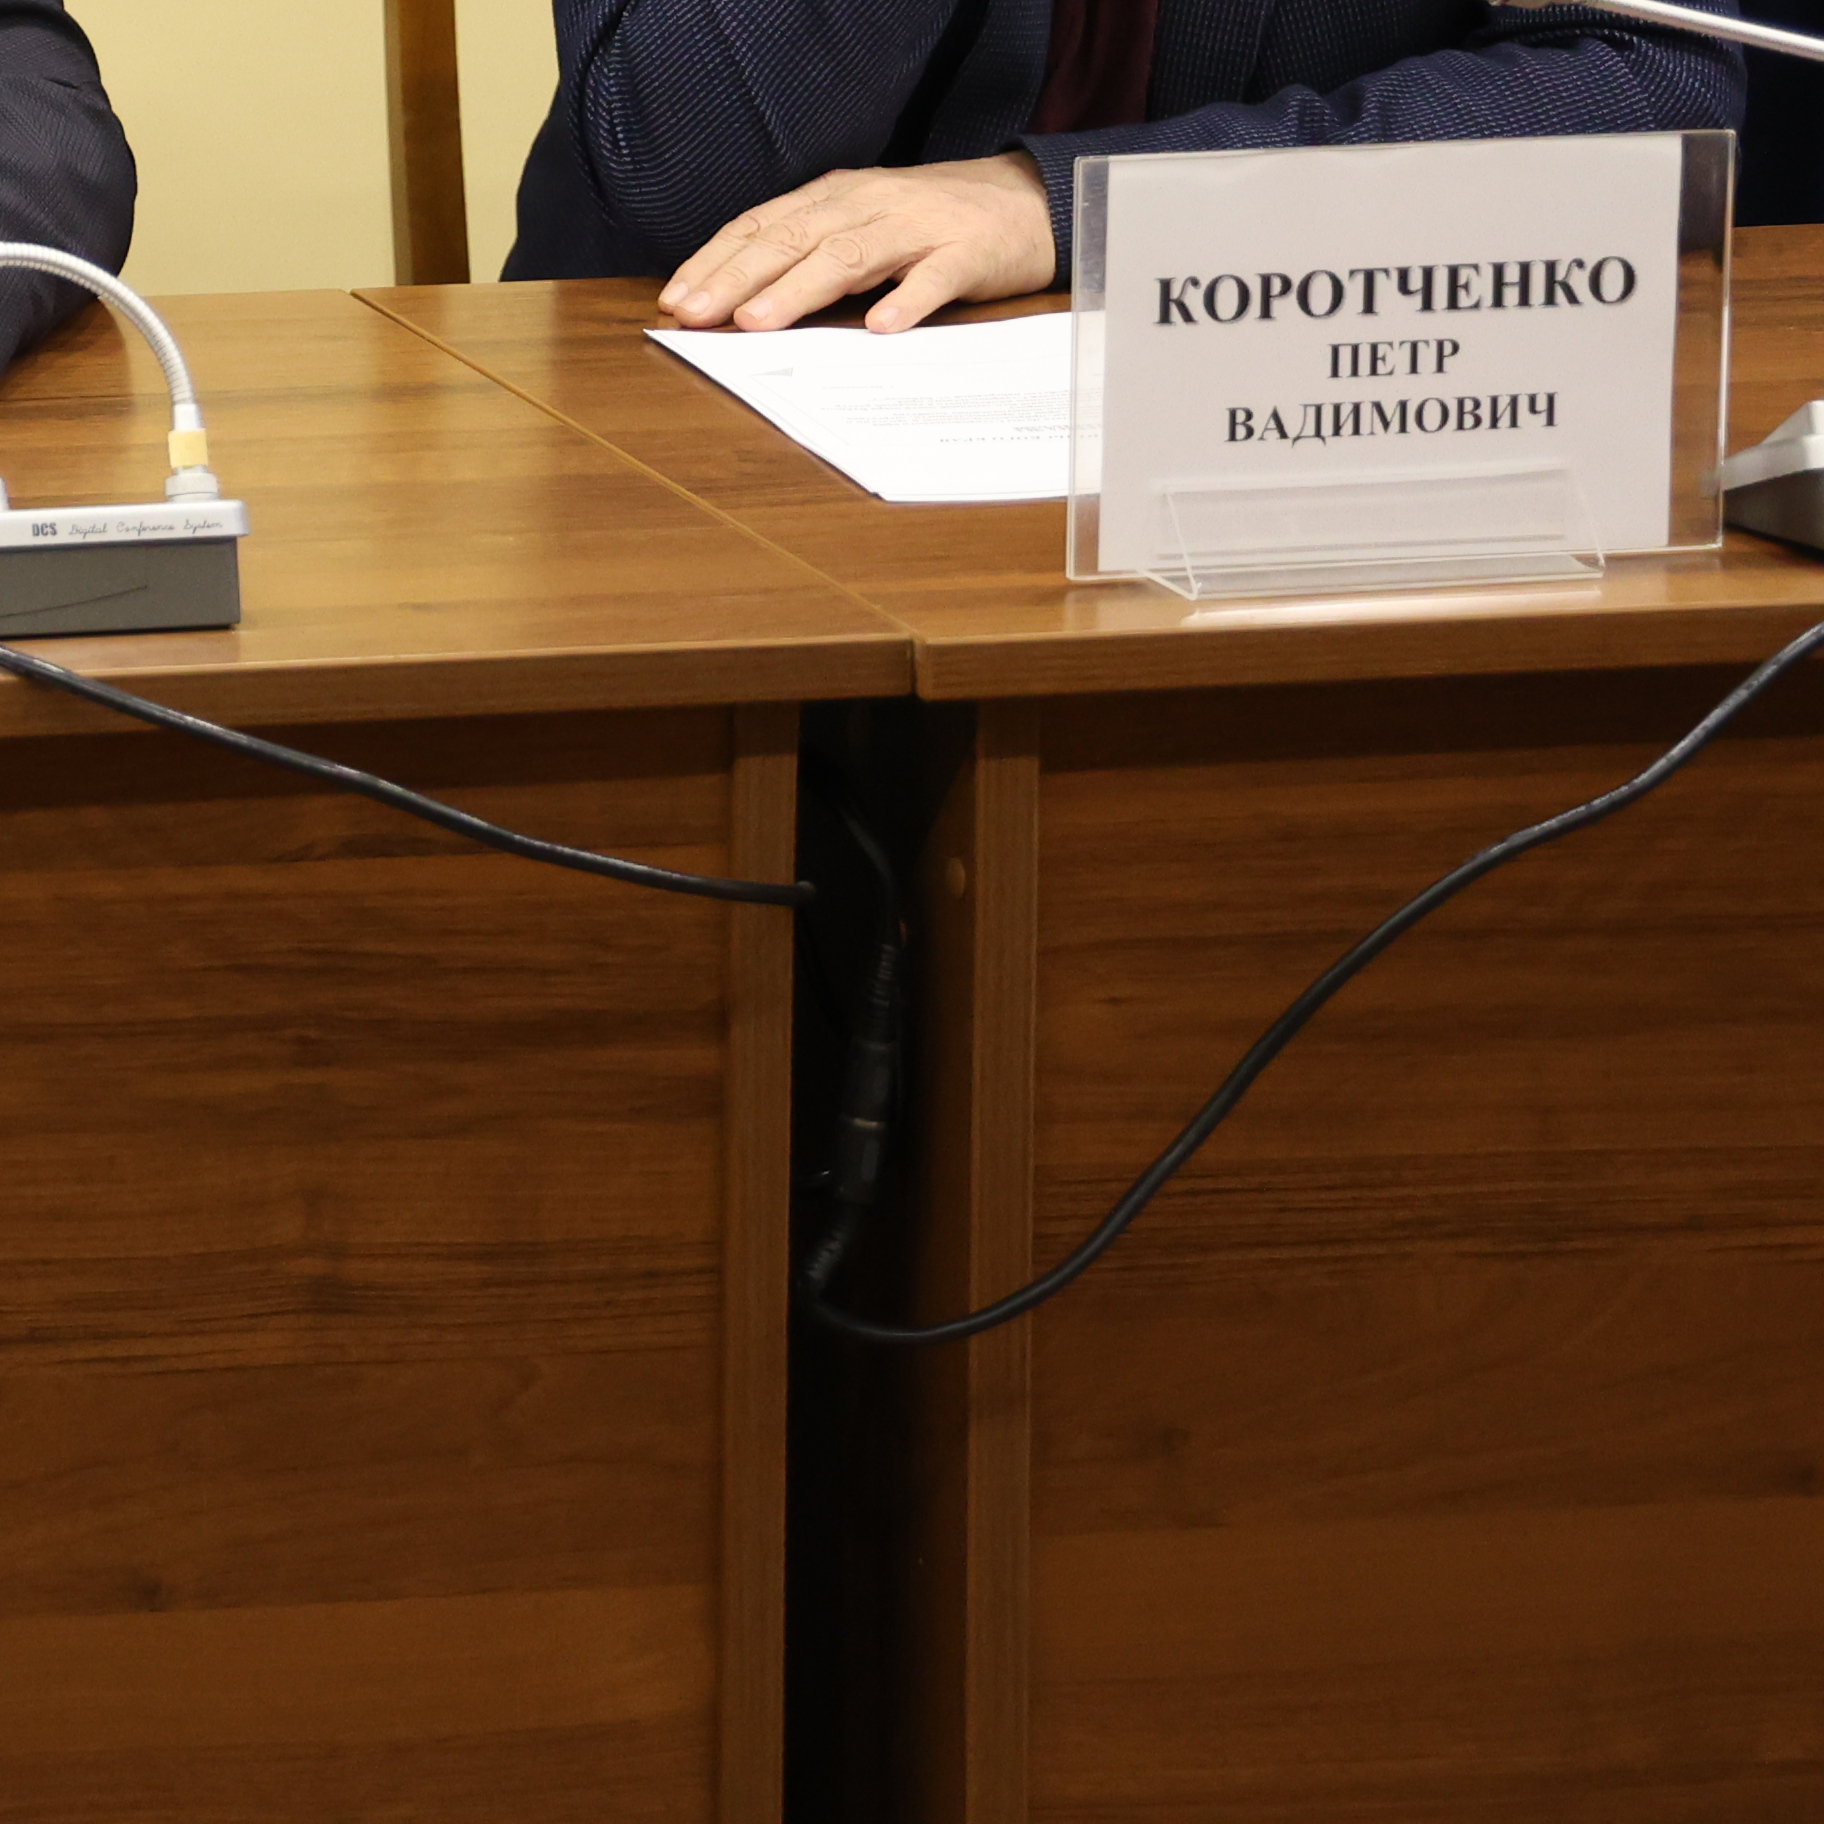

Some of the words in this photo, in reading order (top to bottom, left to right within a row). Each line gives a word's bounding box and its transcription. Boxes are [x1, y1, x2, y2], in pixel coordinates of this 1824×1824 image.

[1154, 255, 1638, 326] КОРОТЧЕНКО
[1328, 337, 1461, 380] ПЕТР
[1225, 390, 1558, 447] ВАДИМОВИЧ
[32, 521, 58, 537] DCS
[68, 523, 108, 539] Digital
[116, 519, 175, 537] Conference
